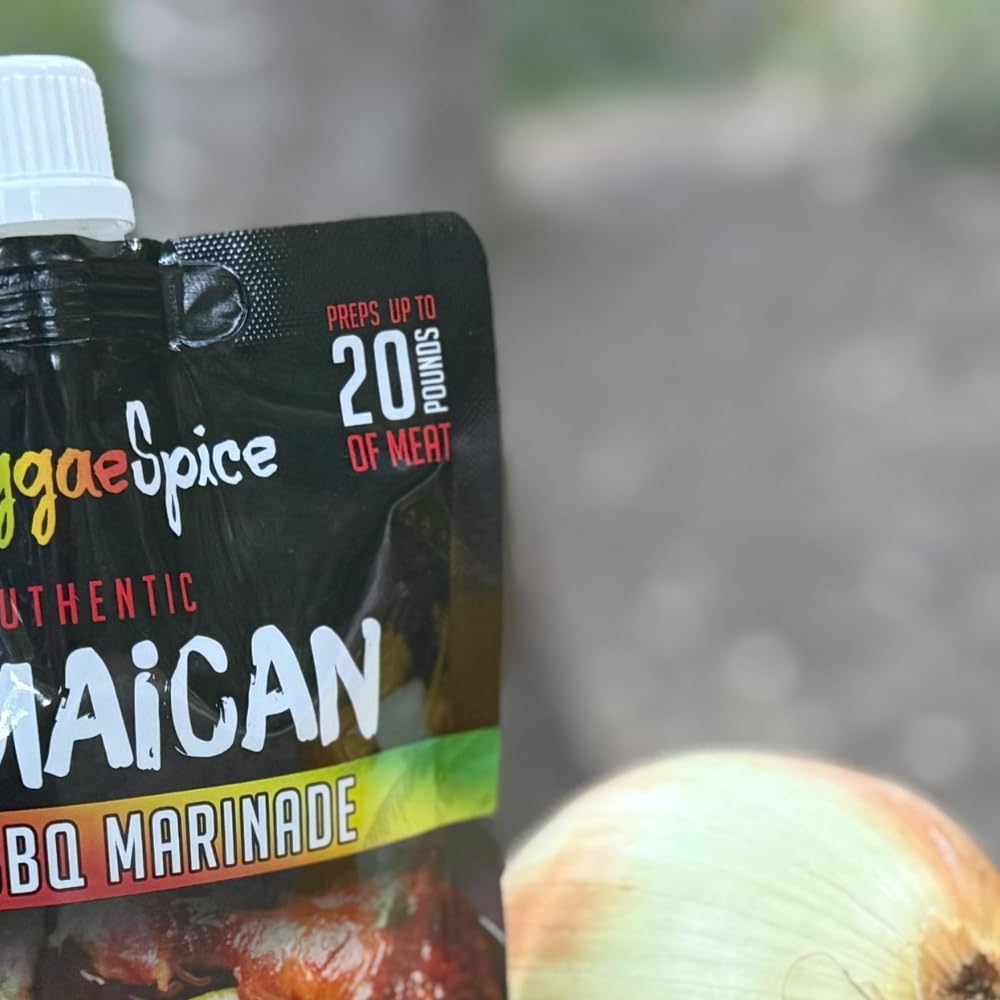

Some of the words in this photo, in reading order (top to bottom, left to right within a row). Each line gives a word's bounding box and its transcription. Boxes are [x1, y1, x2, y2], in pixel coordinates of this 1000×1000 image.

[327, 300, 380, 331] PREPS
[389, 297, 411, 324] UP
[415, 294, 437, 320] TO
[332, 329, 416, 427] 20
[414, 327, 449, 414] POUNDS
[347, 432, 379, 473] OF
[386, 422, 451, 469] MEAT
[105, 775, 358, 885] MARINADE
